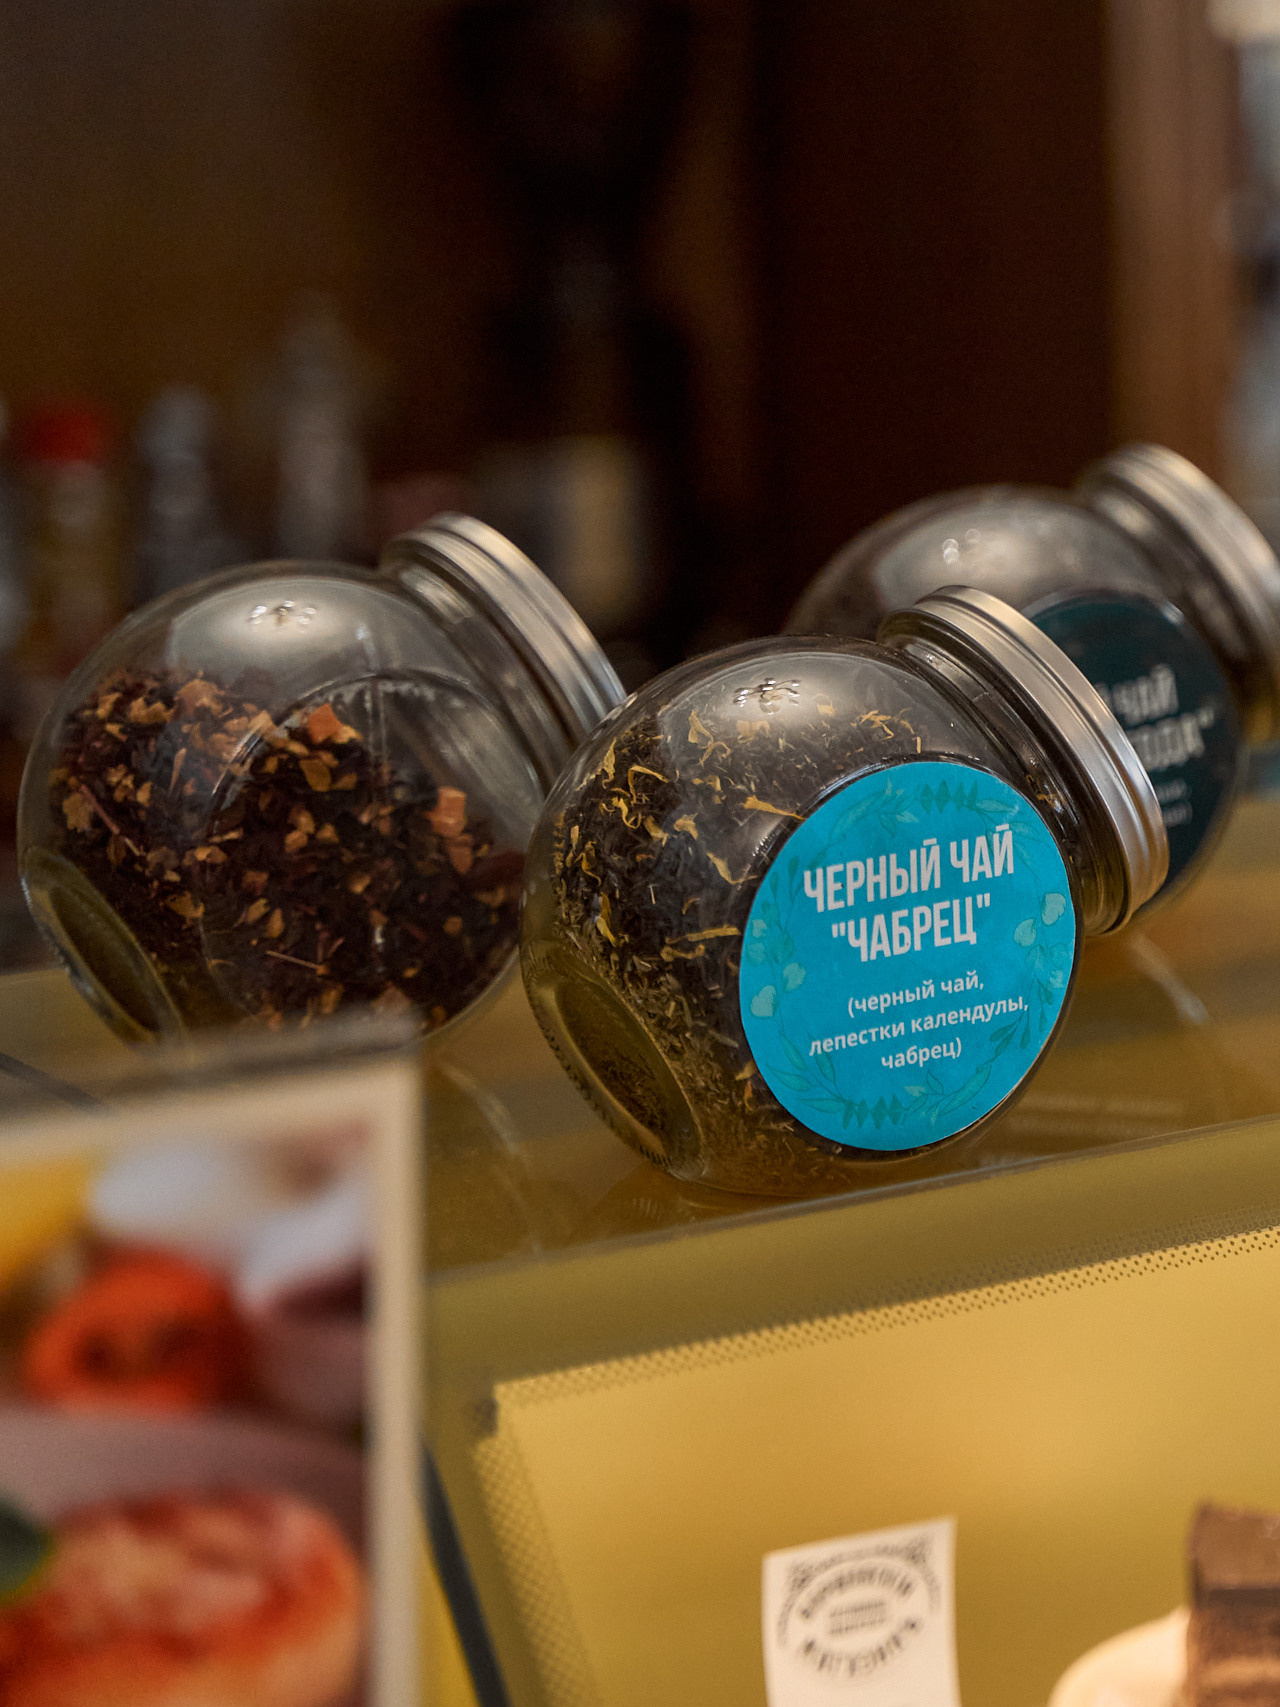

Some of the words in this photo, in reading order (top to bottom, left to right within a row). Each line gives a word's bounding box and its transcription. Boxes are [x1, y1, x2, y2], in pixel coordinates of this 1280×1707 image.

[803, 838, 941, 913] ЧЕРНЫЙ
[949, 824, 1015, 884] ЧАЙ
[831, 893, 991, 963] "ЧАБРЕЦ"
[847, 980, 936, 1019] (черный
[940, 970, 985, 995] чай,
[808, 1021, 906, 1057] лепестки
[910, 995, 1029, 1034] календулы,
[881, 1037, 962, 1070] чабрец)
